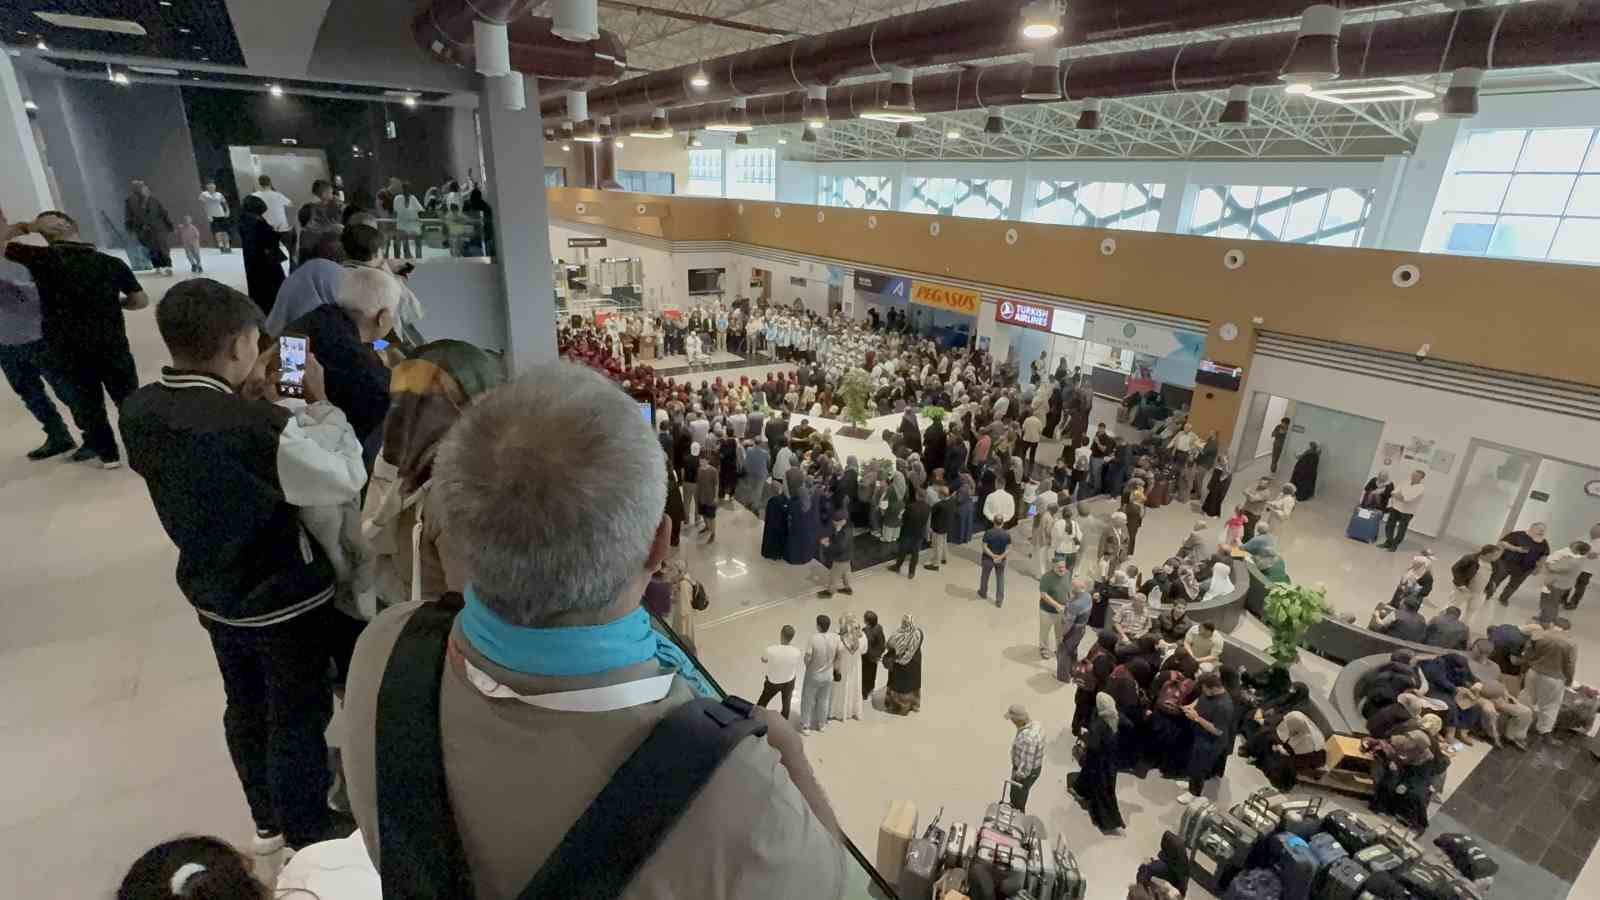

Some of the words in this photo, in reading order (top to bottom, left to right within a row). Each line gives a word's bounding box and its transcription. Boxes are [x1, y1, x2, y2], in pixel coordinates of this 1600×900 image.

[916, 285, 977, 311] PEGASUS
[1016, 304, 1049, 317] TURKISH
[1014, 313, 1048, 327] AIRLINES
